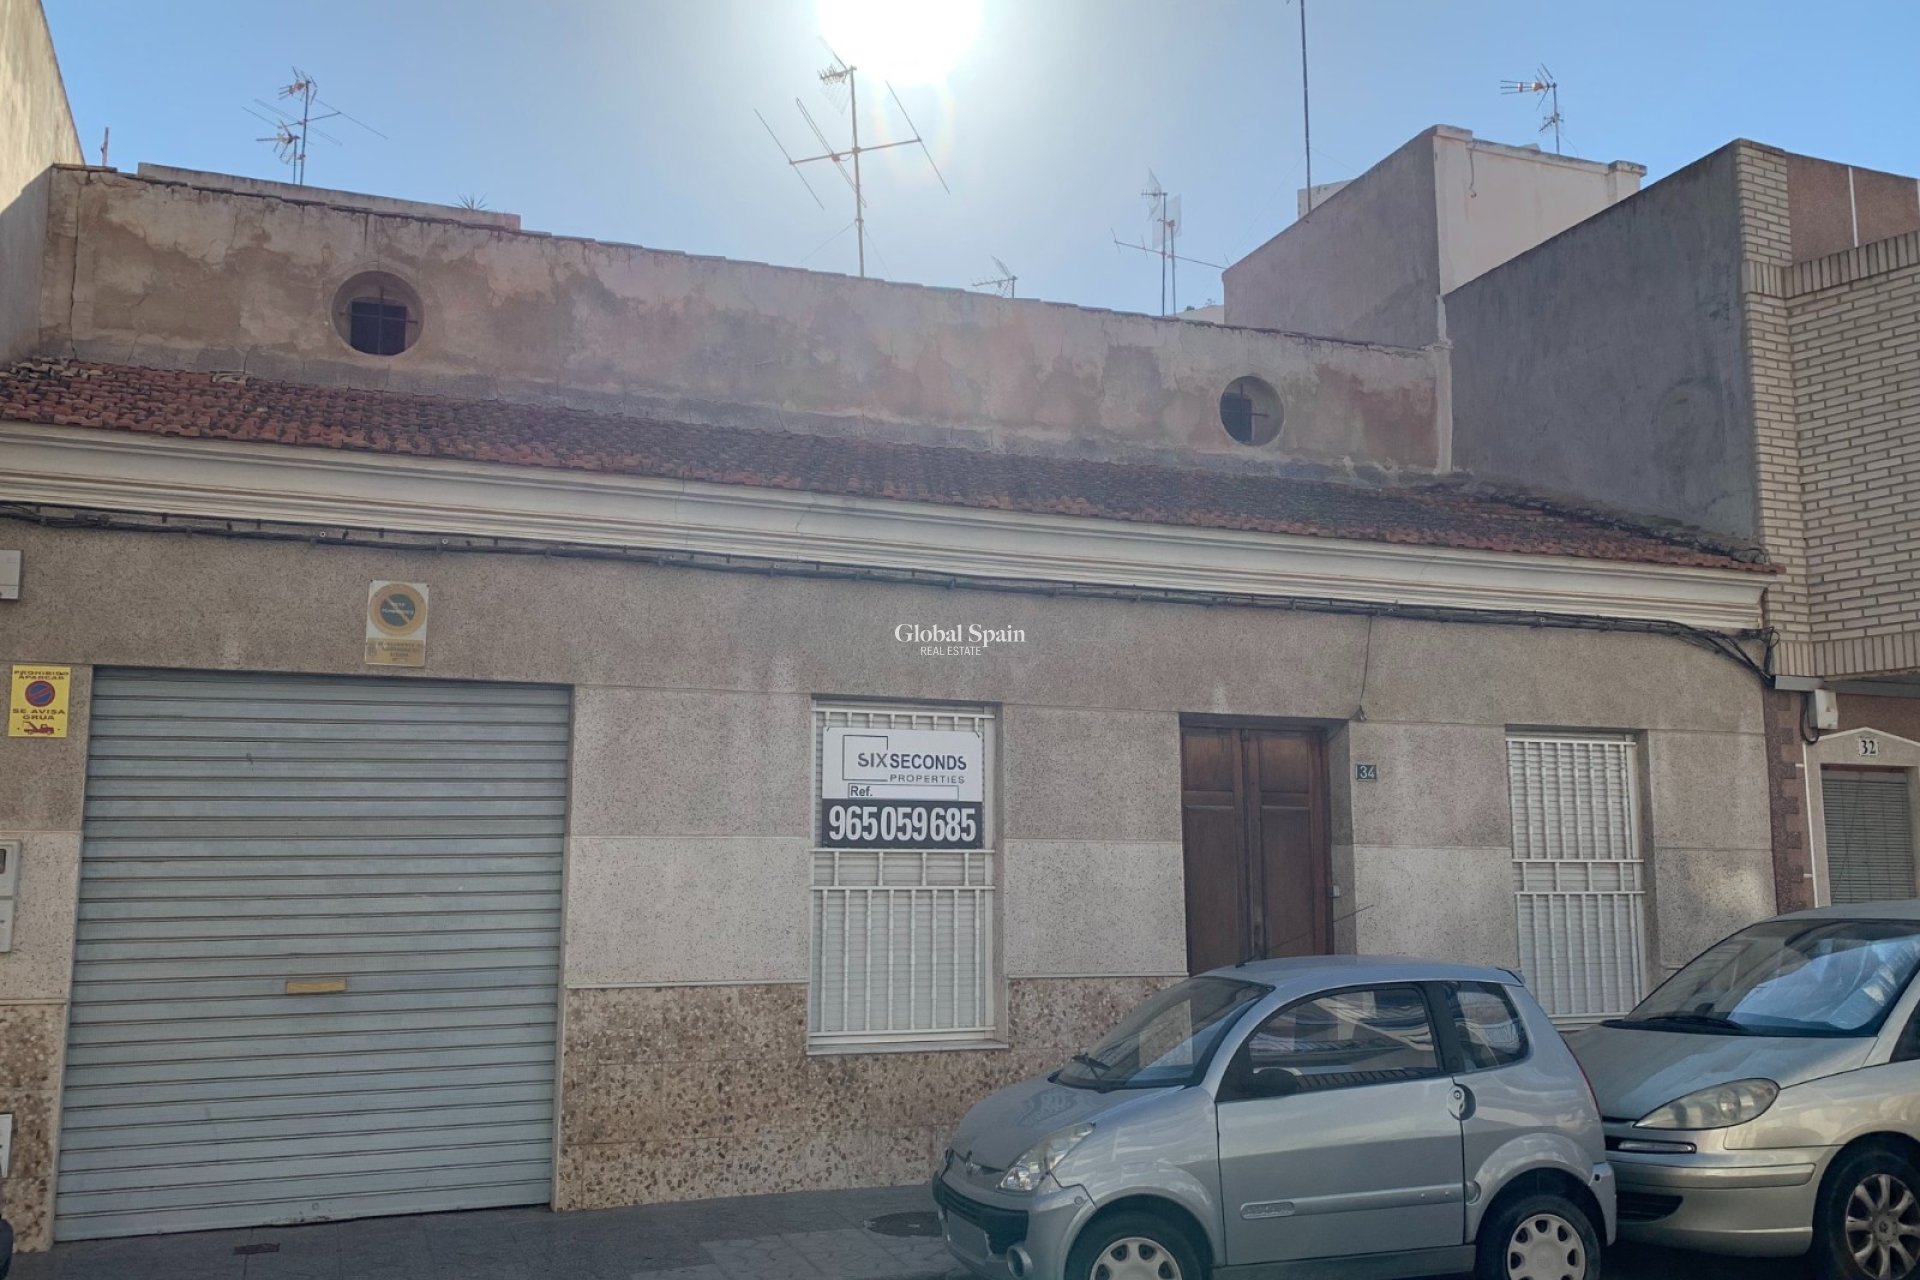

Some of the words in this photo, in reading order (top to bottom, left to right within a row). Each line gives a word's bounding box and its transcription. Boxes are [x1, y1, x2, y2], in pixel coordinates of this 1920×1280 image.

[1861, 740, 1876, 754] 32
[1360, 765, 1375, 779] 34
[890, 774, 965, 784] PROPERTIES
[850, 785, 873, 797] Ref.
